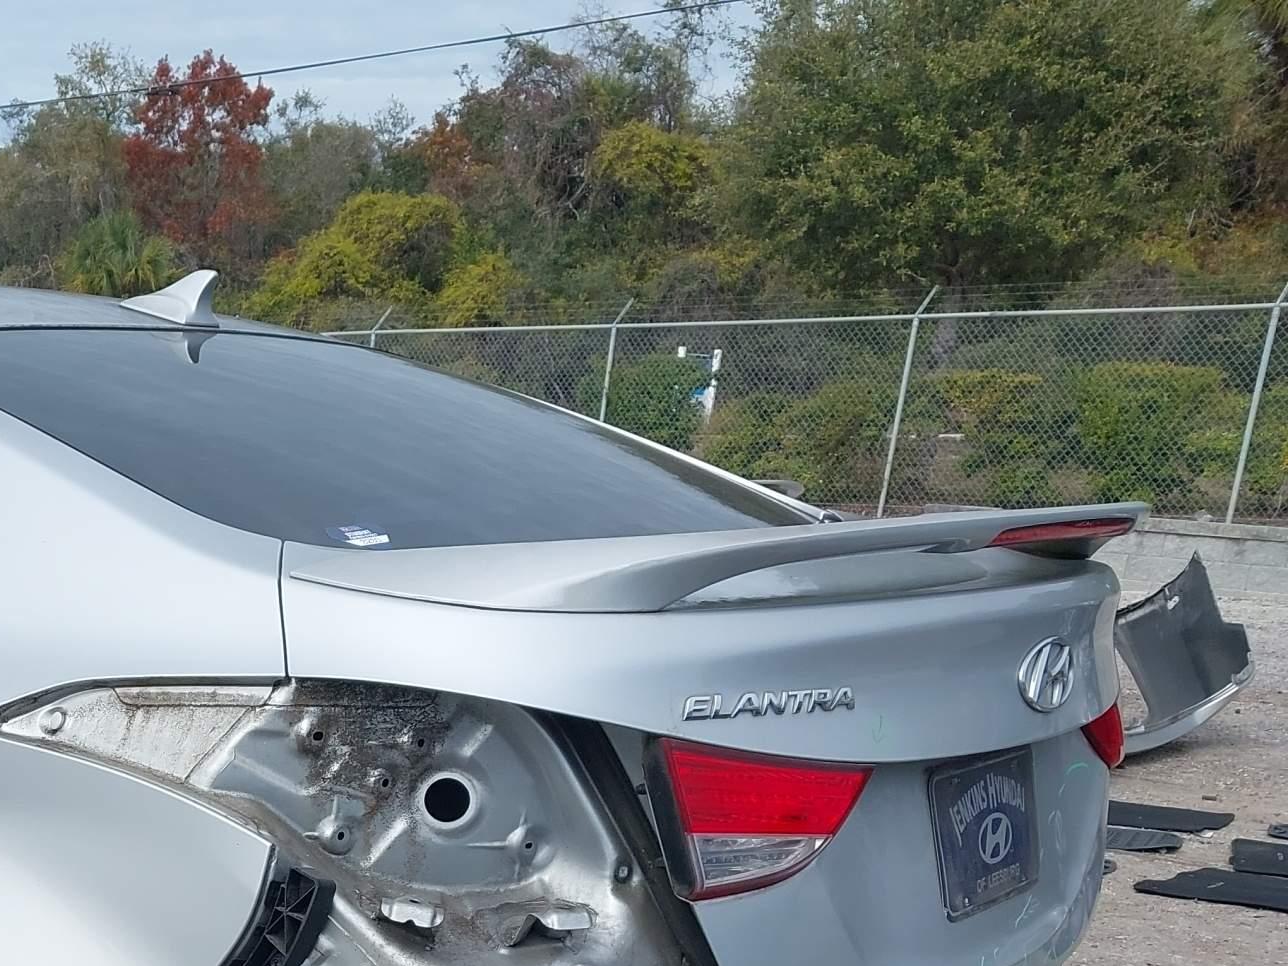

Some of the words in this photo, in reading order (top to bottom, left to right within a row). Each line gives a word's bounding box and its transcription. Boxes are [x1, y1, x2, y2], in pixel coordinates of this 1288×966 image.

[682, 686, 856, 721] ELANTRA
[949, 779, 988, 847] JENKINS
[986, 772, 1025, 813] HYUNDAI
[977, 877, 987, 893] OF
